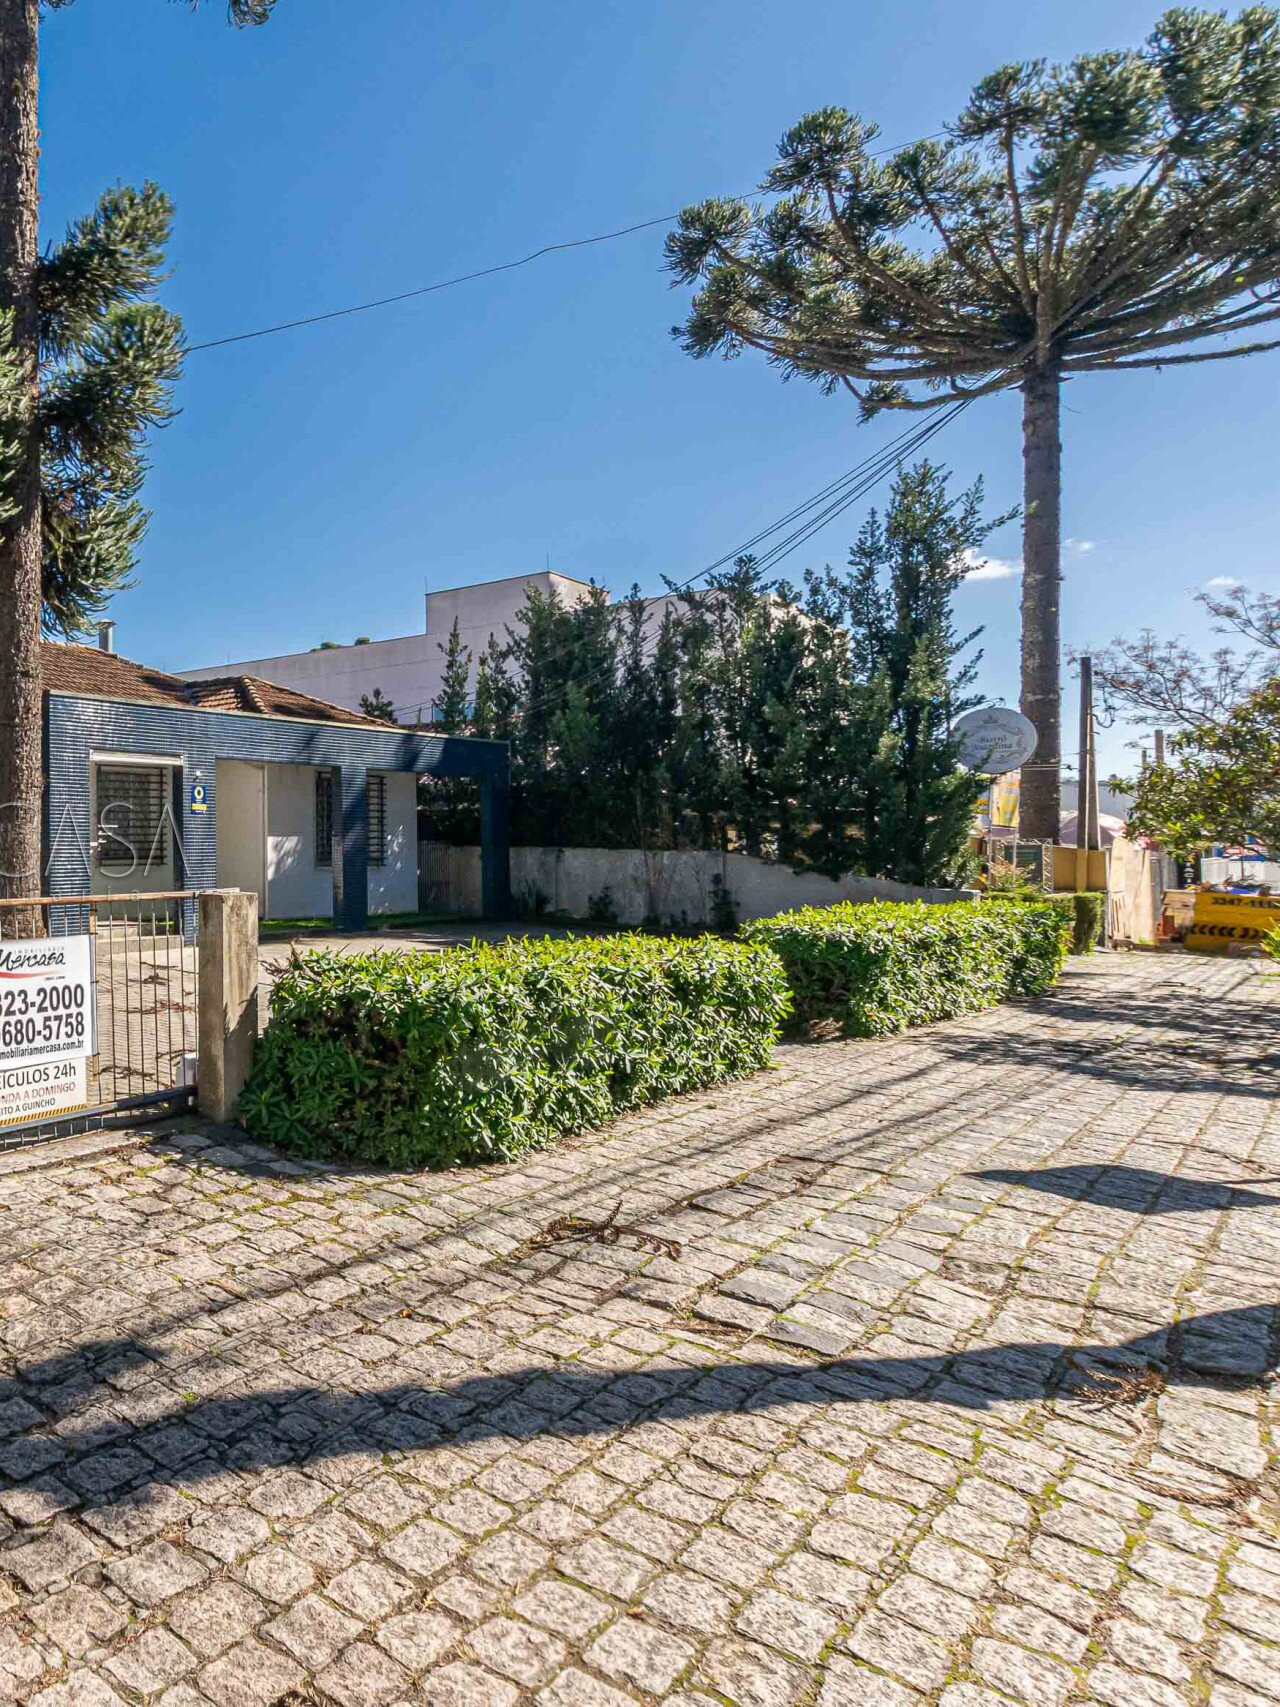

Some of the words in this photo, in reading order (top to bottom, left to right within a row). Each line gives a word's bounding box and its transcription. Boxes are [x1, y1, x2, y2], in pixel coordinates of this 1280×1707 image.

[53, 1062, 76, 1080] 24h
[23, 1091, 30, 1100] A
[32, 1081, 76, 1098] DOMINGO
[22, 1098, 56, 1111] GUINCHO
